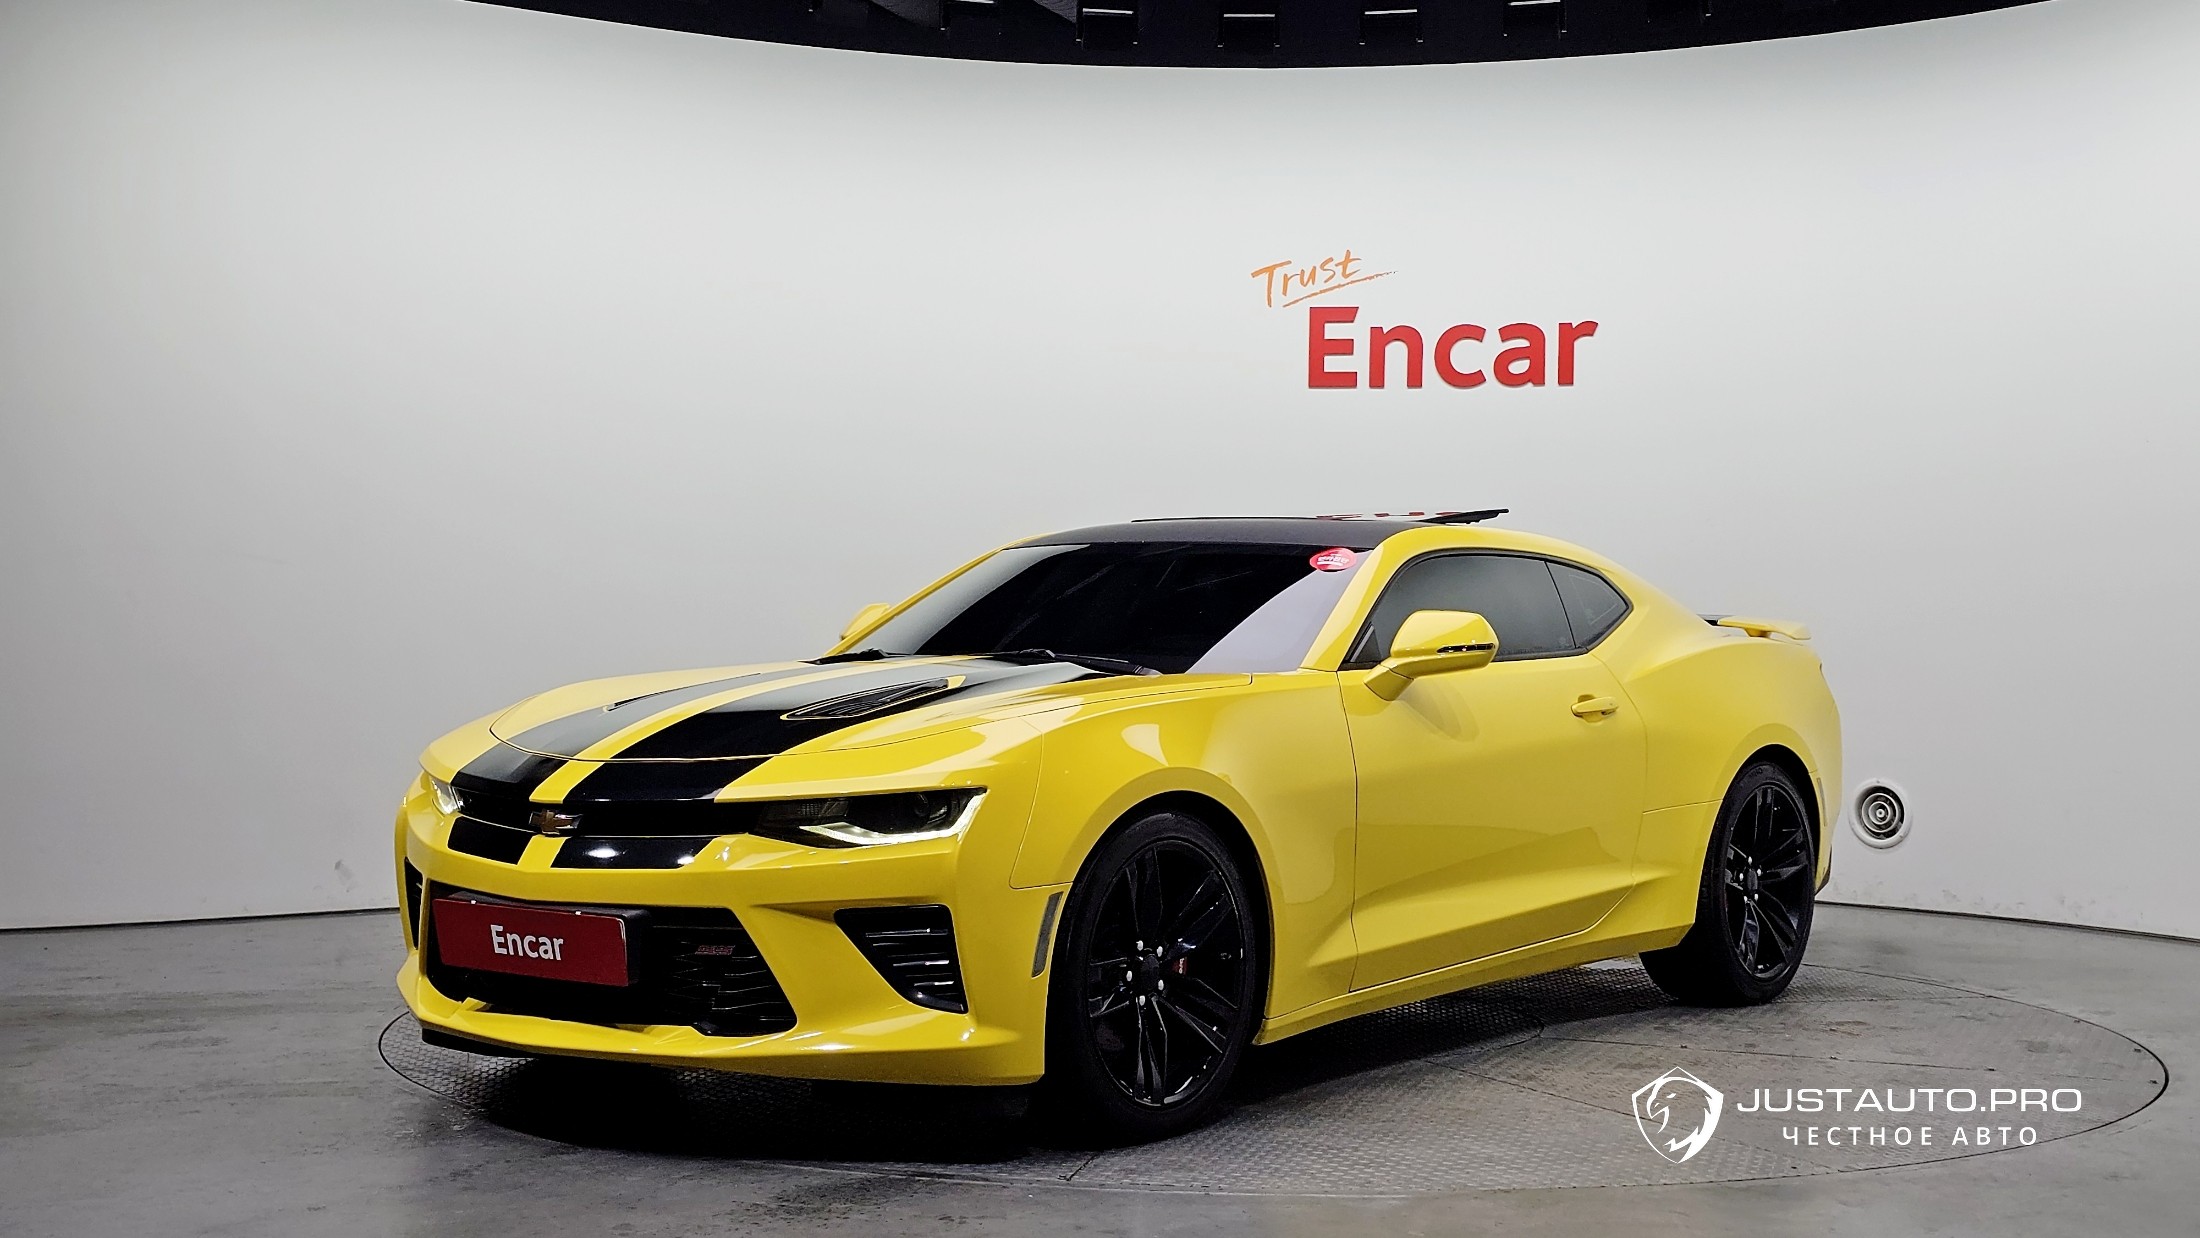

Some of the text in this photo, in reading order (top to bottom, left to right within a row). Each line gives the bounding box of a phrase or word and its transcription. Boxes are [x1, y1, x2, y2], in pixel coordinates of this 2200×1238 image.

[1251, 249, 1362, 308] Trust
[1308, 306, 1599, 389] Encar
[490, 924, 564, 961] Encar
